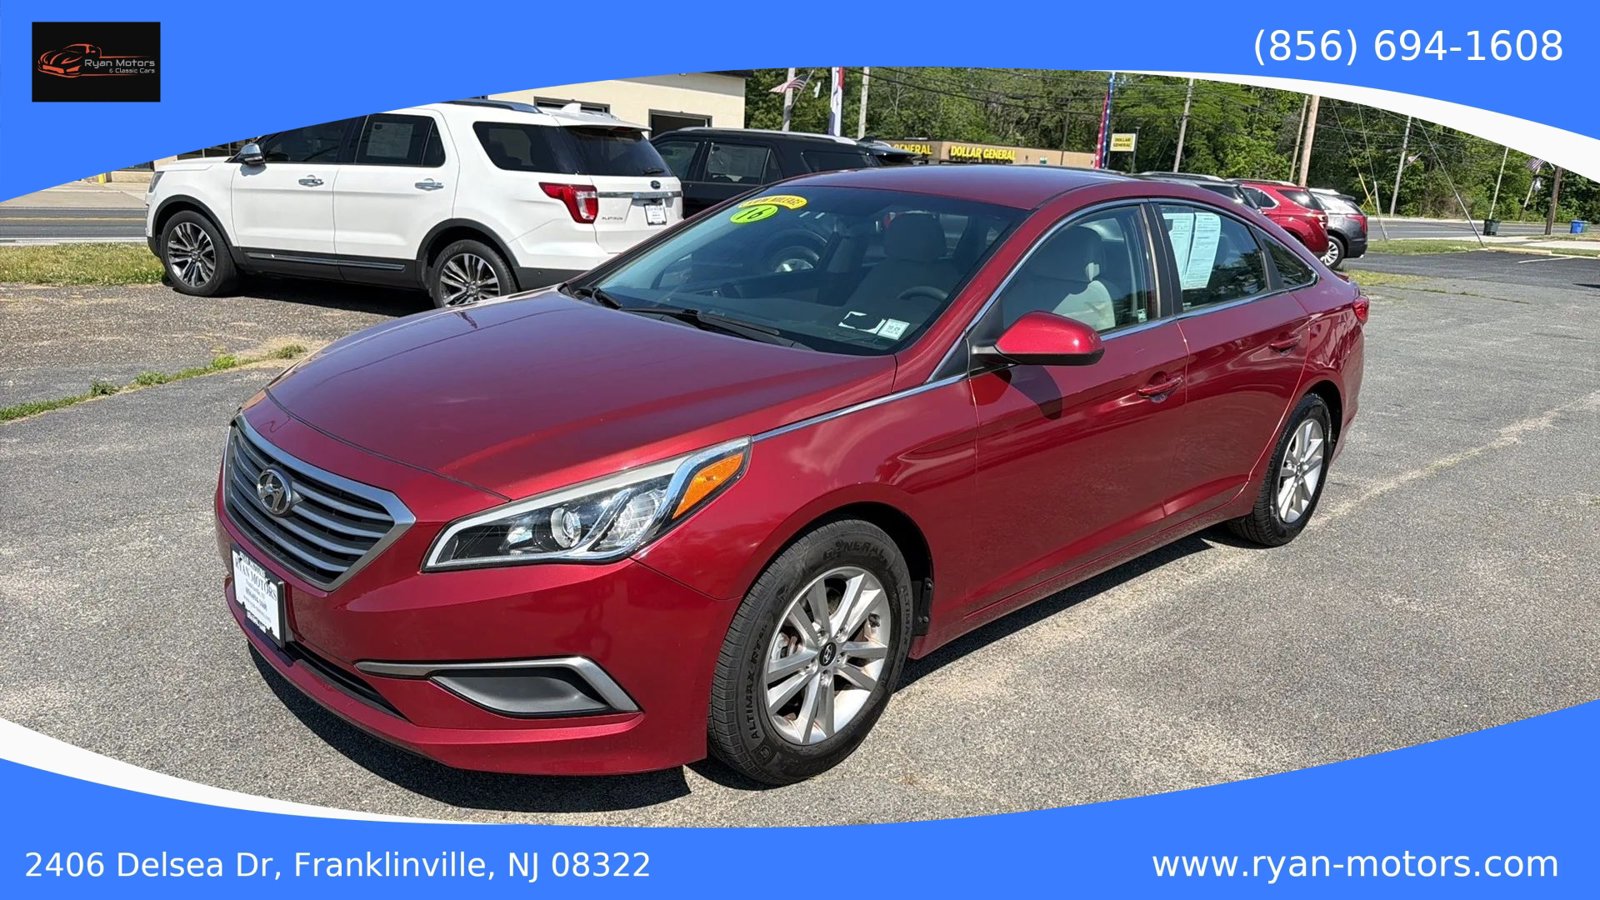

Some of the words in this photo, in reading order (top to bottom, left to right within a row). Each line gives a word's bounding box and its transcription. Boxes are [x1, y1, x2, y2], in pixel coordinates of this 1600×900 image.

[950, 145, 982, 158] DOLLAR
[983, 147, 1016, 160] GENERAL
[745, 671, 760, 740] ALTIMAX
